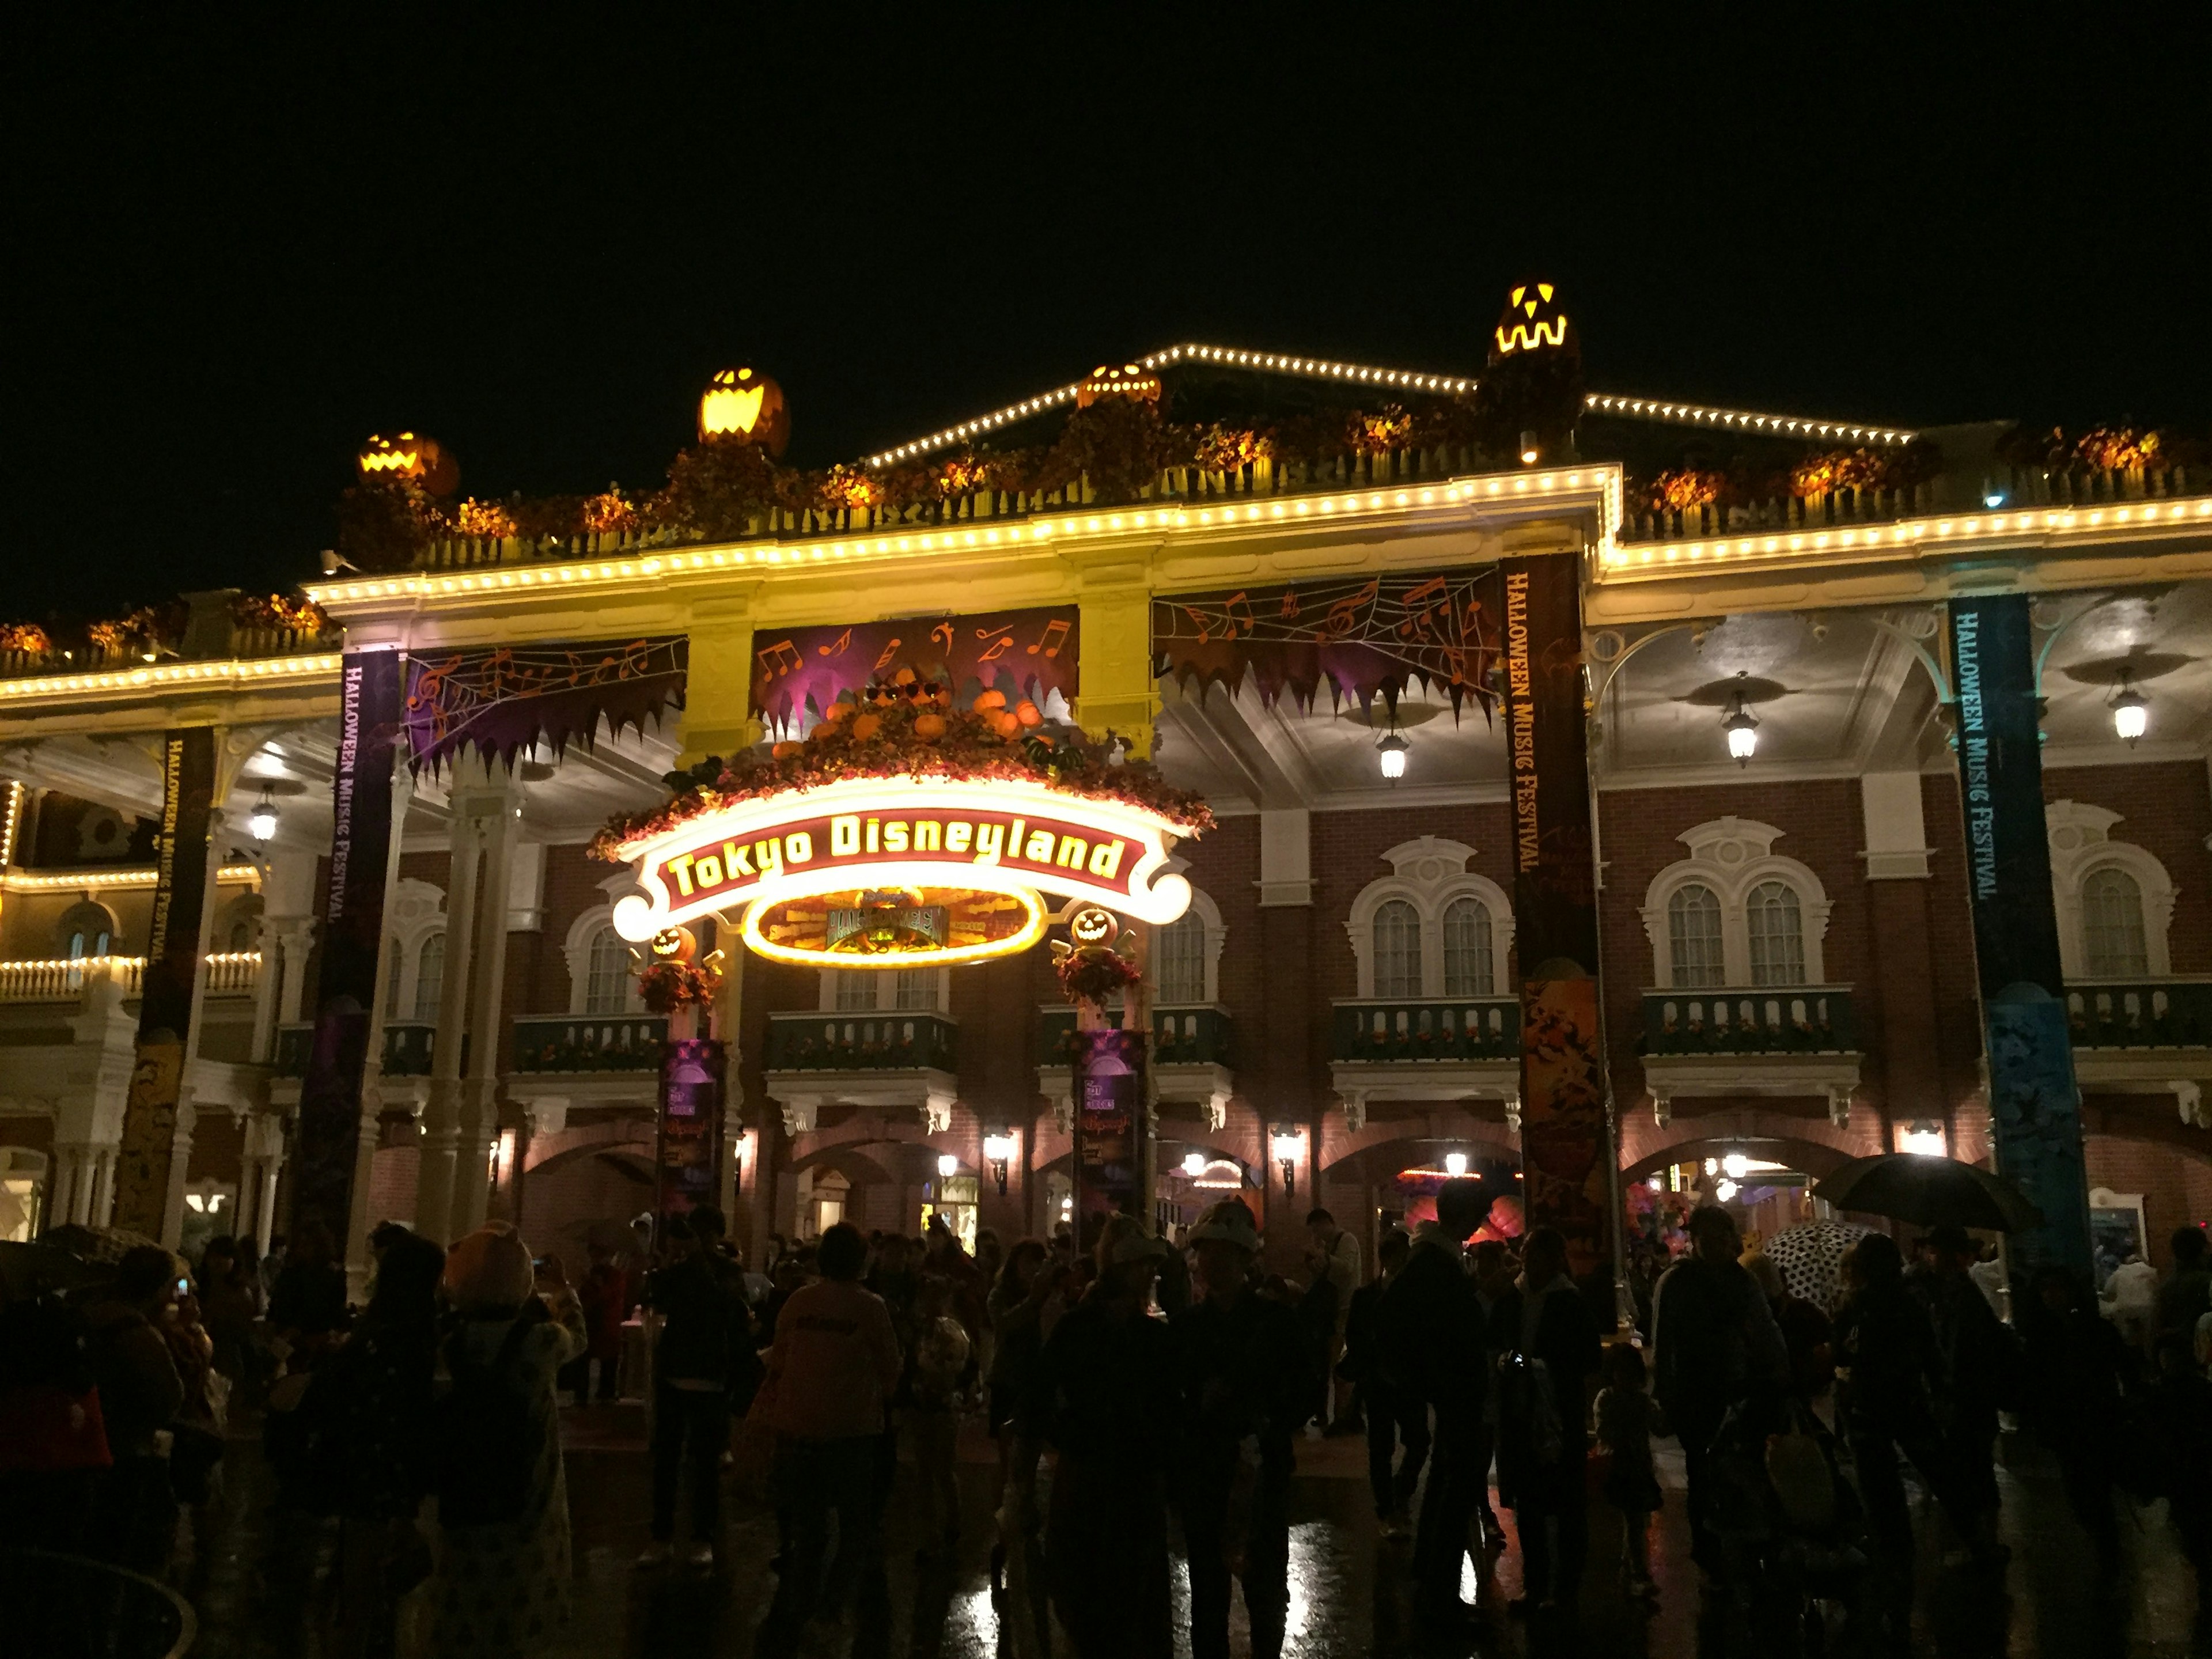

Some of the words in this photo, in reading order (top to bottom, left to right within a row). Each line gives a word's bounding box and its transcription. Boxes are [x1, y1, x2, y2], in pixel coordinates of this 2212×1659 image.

[1506, 572, 1530, 696] HALLOWEEN
[1956, 612, 1983, 732] HALLOWEEN
[340, 666, 363, 772] HALLOWEEN
[1512, 702, 1534, 770] MUSIC
[164, 740, 184, 834] HALLOWEEN
[337, 779, 354, 836] MUSIC
[1966, 737, 1990, 802] MUSIC
[160, 838, 175, 888] MUSIC
[668, 832, 813, 896] Tokyo
[831, 815, 1125, 880] Disneyland
[1516, 774, 1540, 873] FESTIVAL
[1971, 806, 1998, 900] FESTIVAL
[328, 840, 350, 924] FESTIVAL
[150, 893, 172, 965] FESTIVAL
